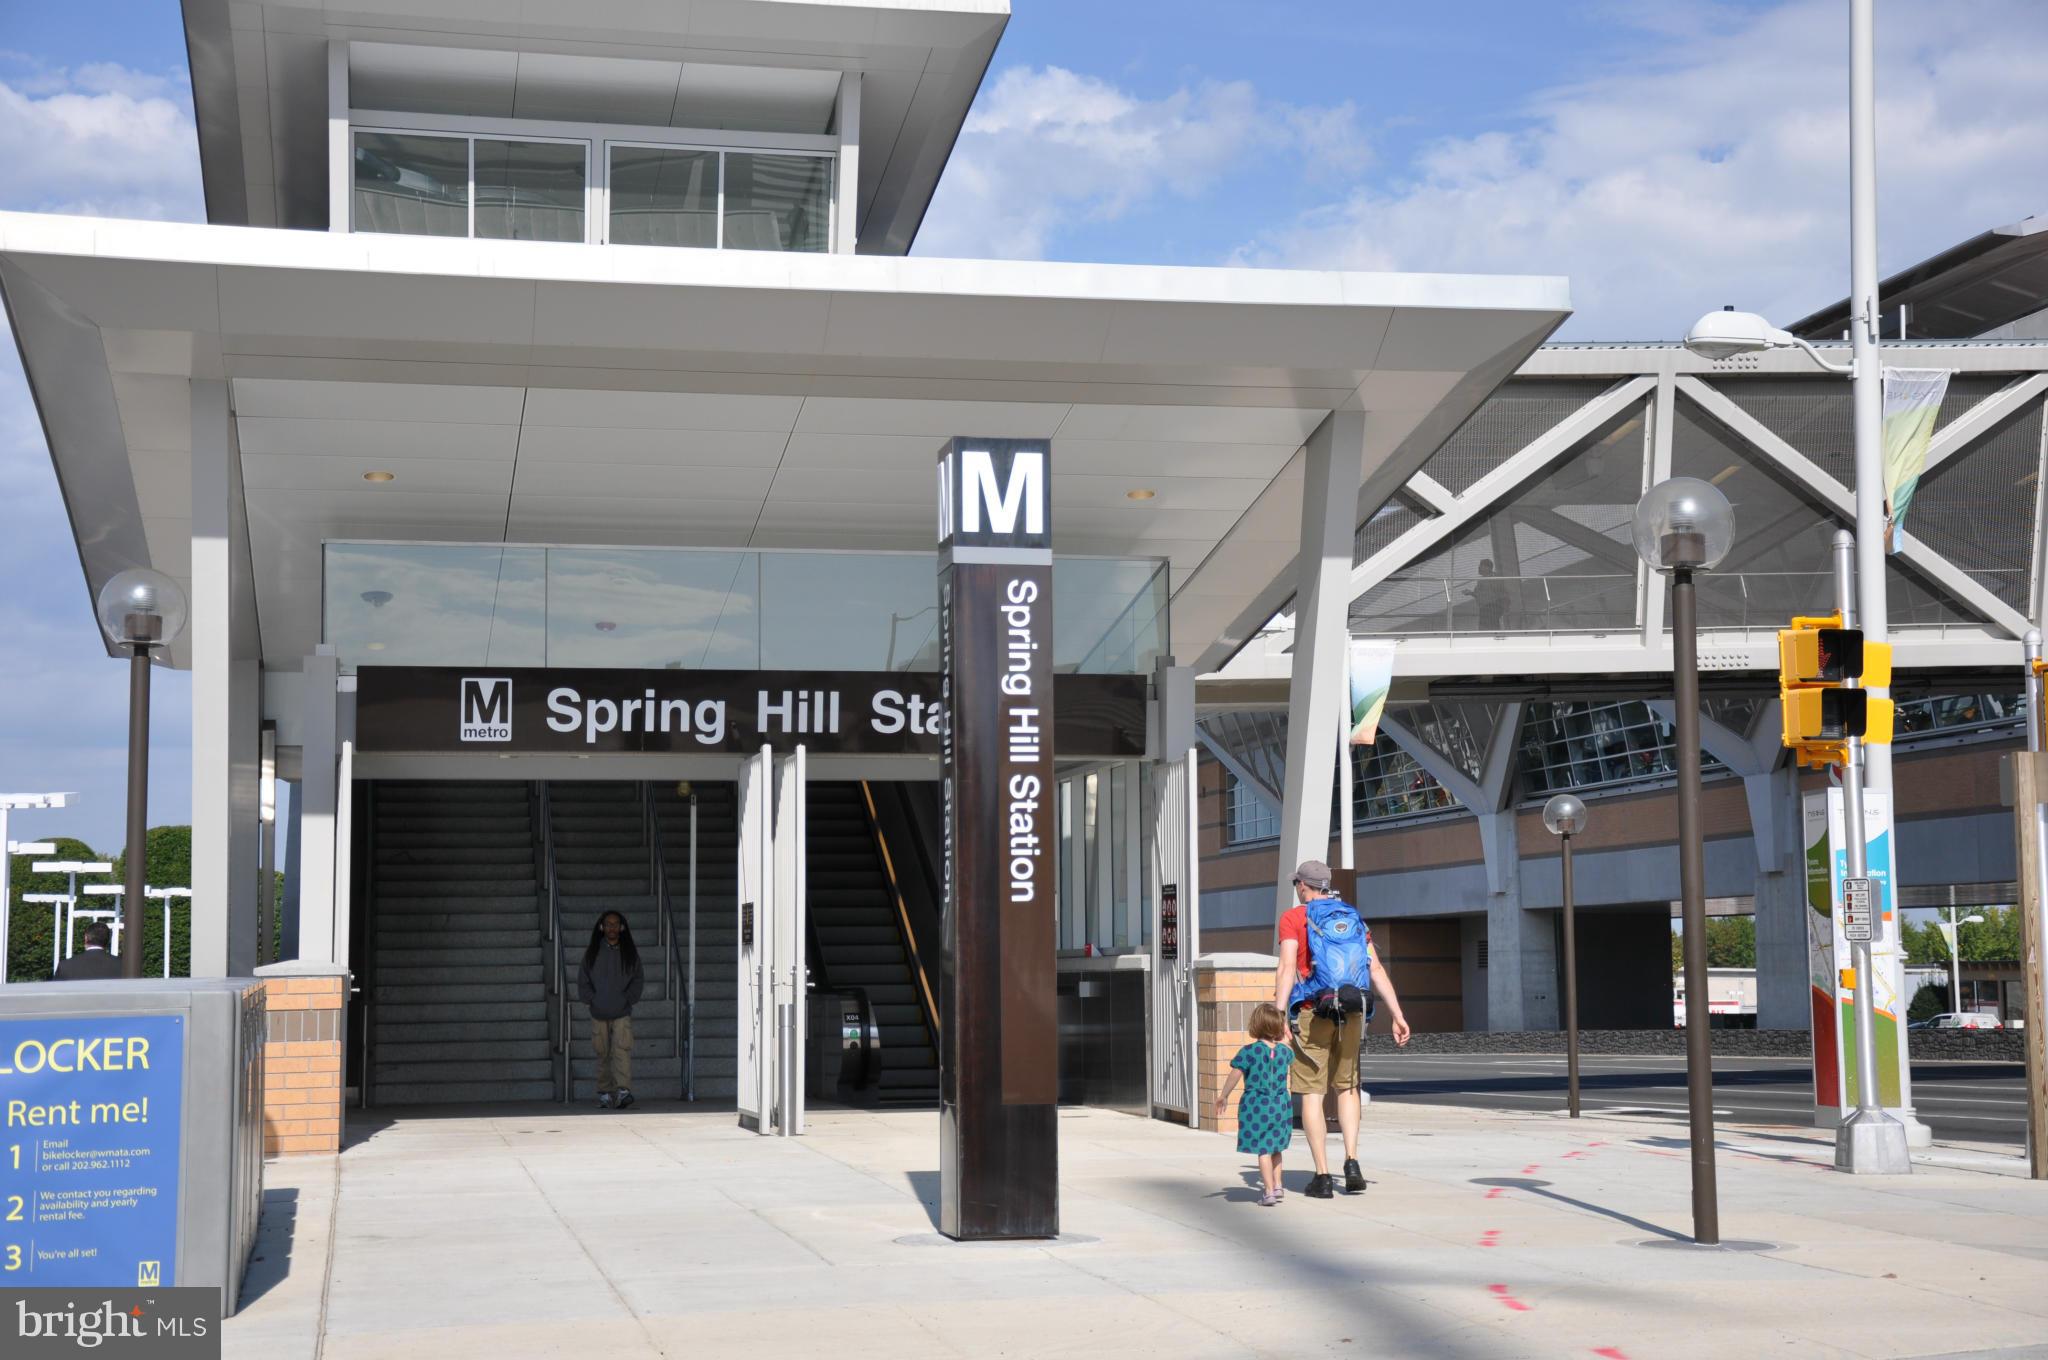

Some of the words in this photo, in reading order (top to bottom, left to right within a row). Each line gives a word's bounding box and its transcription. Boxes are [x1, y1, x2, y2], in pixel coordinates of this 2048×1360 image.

[962, 451, 1043, 534] M
[1000, 579, 1038, 695] Spring
[464, 681, 509, 724] M
[546, 687, 726, 744] Spring
[757, 690, 840, 733] Hill
[464, 725, 509, 738] metro
[1009, 708, 1039, 762] Hill
[1009, 774, 1041, 902] Station
[8, 1100, 81, 1127] Rent
[91, 1097, 148, 1123] me!
[42, 1148, 151, 1161] bikelocker@wmata.com
[43, 1139, 69, 1149] Email
[10, 1144, 20, 1170] 1
[42, 1164, 52, 1172] or
[54, 1162, 70, 1171] call
[72, 1160, 130, 1170] 202.962.1112
[40, 1191, 55, 1200] We
[57, 1189, 92, 1199] contact
[94, 1190, 111, 1200] you
[113, 1187, 157, 1199] regarding
[40, 1199, 89, 1211] availability
[91, 1199, 109, 1208] and
[110, 1197, 138, 1209] yearly
[6, 1196, 24, 1221] 2
[40, 1211, 66, 1221] rental
[68, 1211, 85, 1220] fee.
[4, 1245, 22, 1271] 3
[37, 1250, 66, 1260] You're
[68, 1249, 79, 1258] all
[81, 1248, 97, 1258] set!
[141, 1263, 157, 1280] M
